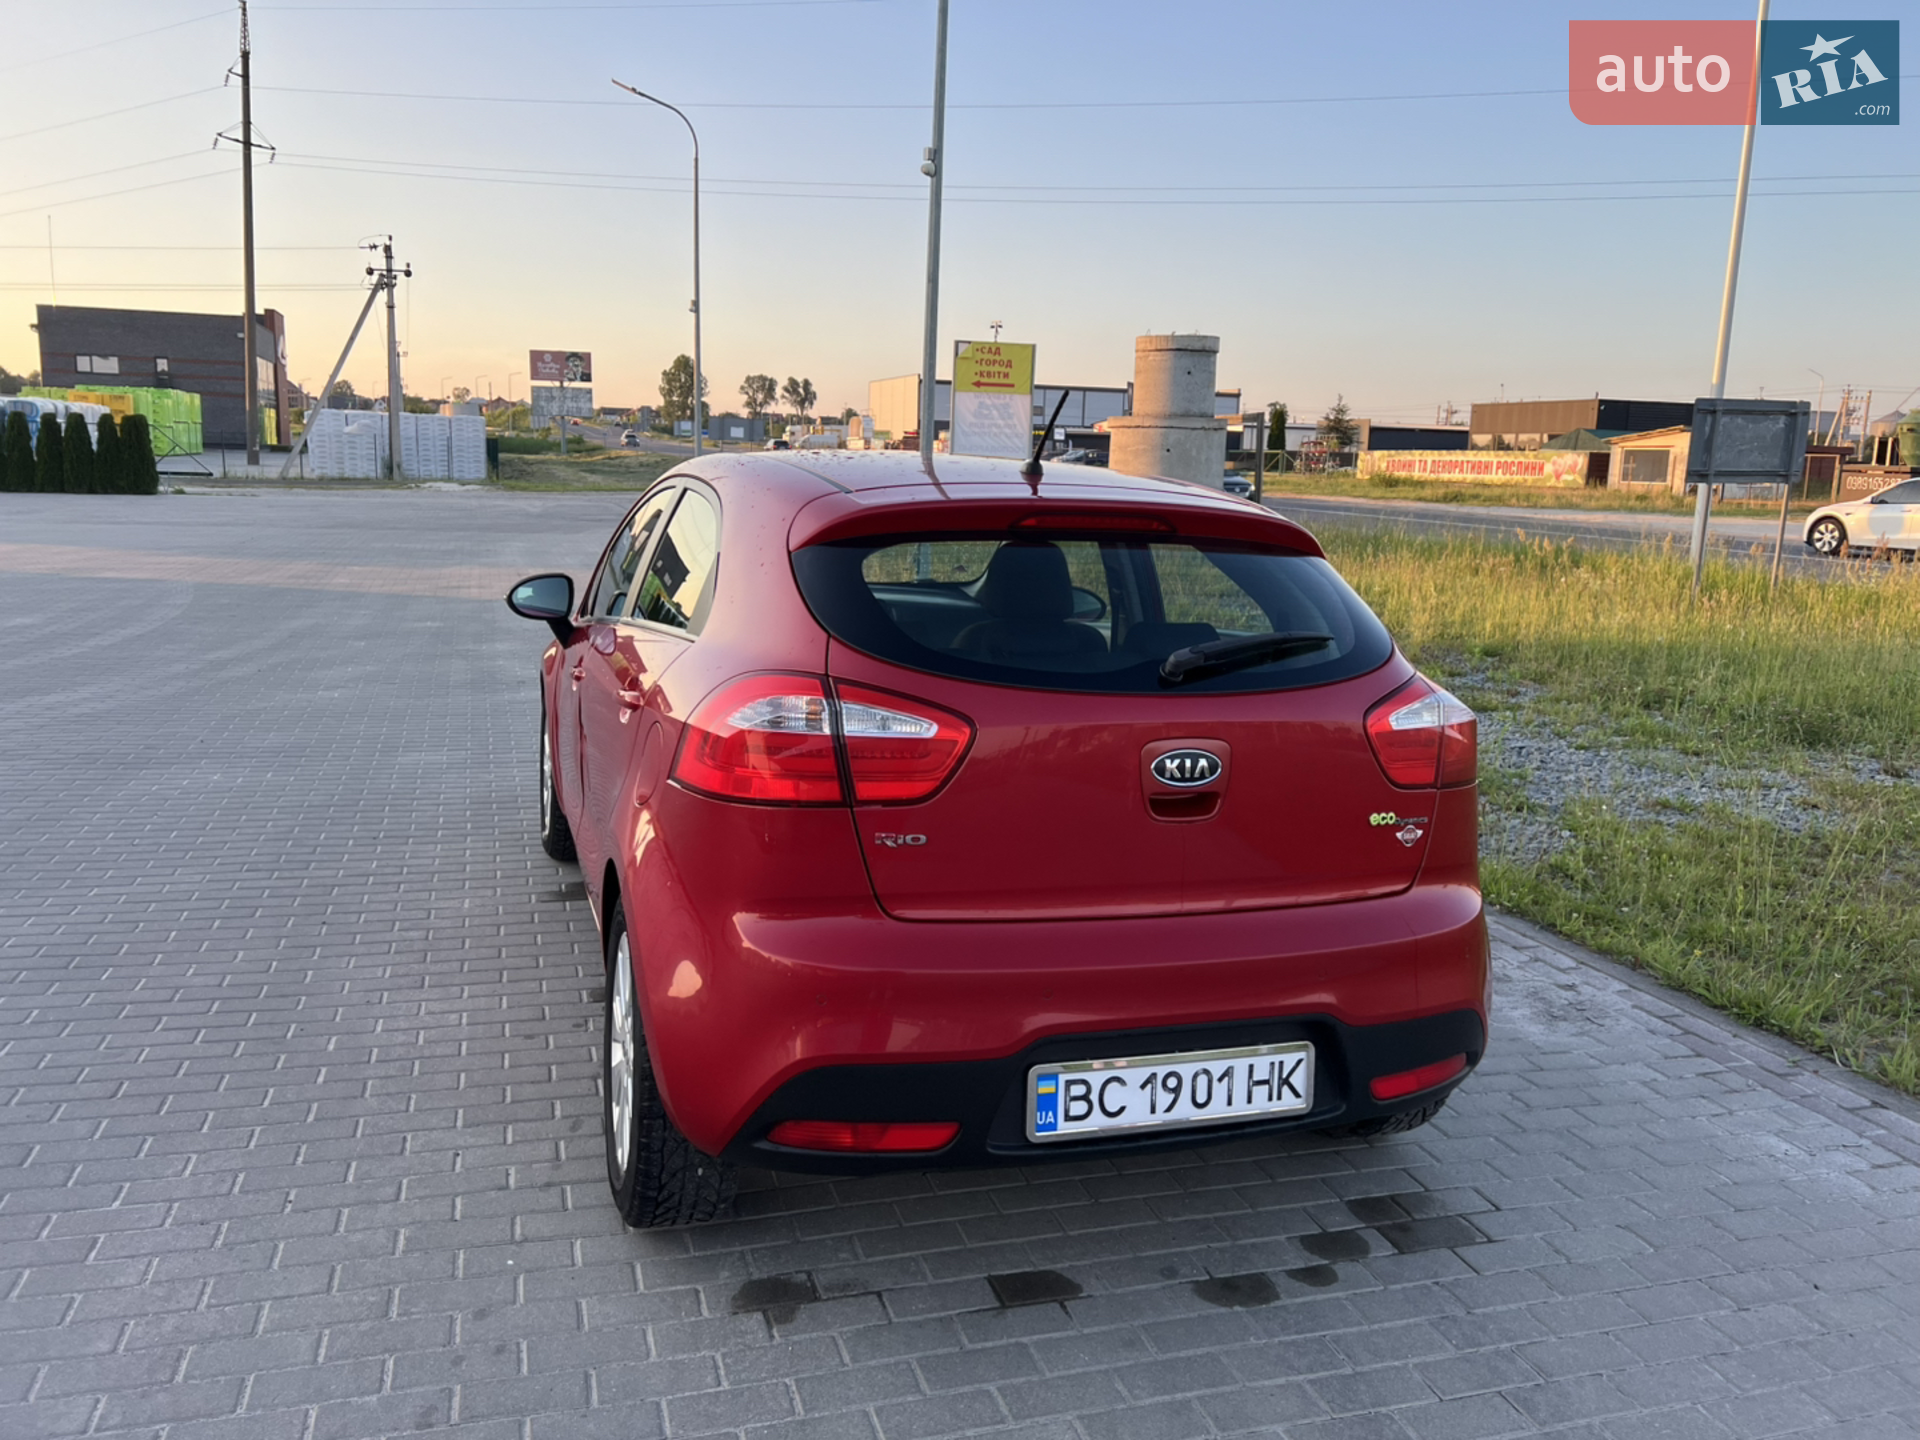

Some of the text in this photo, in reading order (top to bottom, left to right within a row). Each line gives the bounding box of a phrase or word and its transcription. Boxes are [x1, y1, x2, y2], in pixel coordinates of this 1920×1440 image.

[1418, 459, 1428, 474] ТА
[1429, 460, 1494, 476] ДЕКОРАТИВНІ
[1495, 460, 1545, 477] РОСЛИНИ
[1163, 757, 1212, 780] KIA
[874, 832, 927, 848] RIO
[1063, 1057, 1305, 1122] BC 1901 HK
[1036, 1110, 1056, 1125] UA
